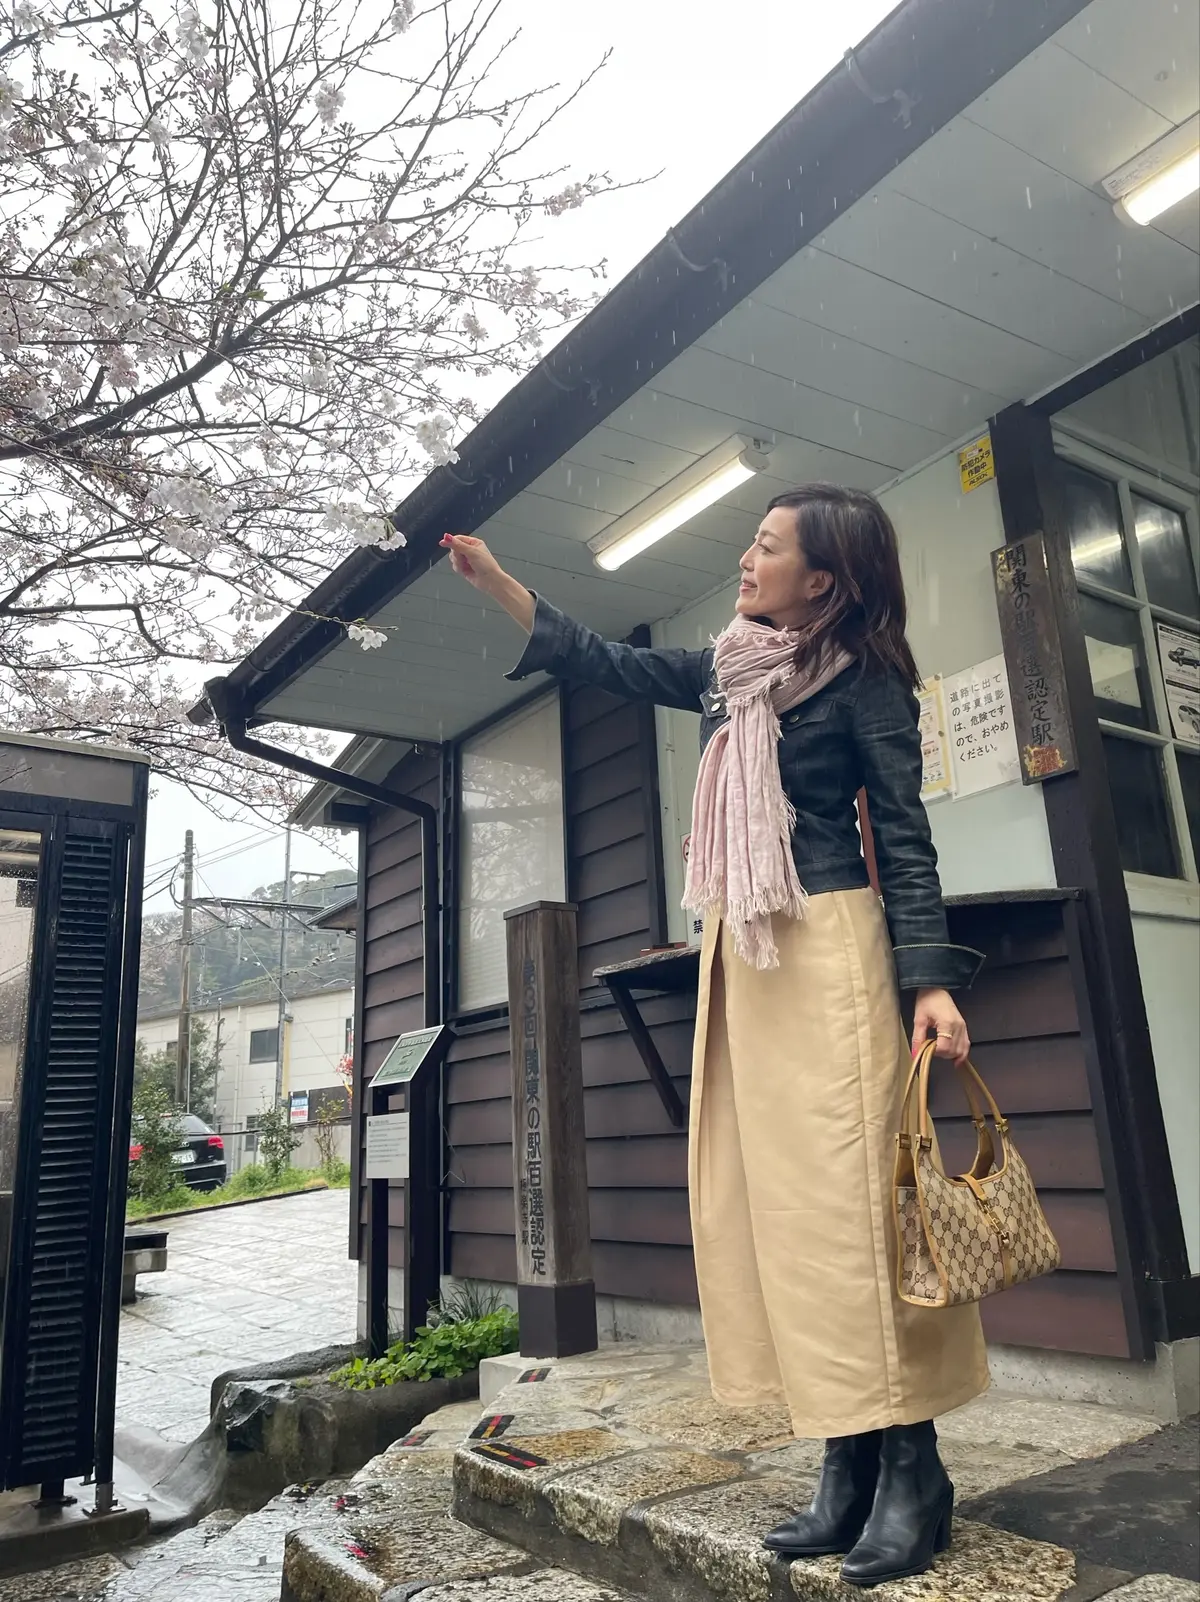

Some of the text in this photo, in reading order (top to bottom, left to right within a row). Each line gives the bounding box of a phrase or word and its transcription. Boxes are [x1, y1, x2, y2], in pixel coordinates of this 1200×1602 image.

[950, 673, 1002, 704] 道路に出て
[952, 688, 1005, 717] の写真撮影
[954, 704, 1006, 732] は、危険です
[956, 720, 1009, 747] ので、おやめ
[959, 743, 998, 762] ください。
